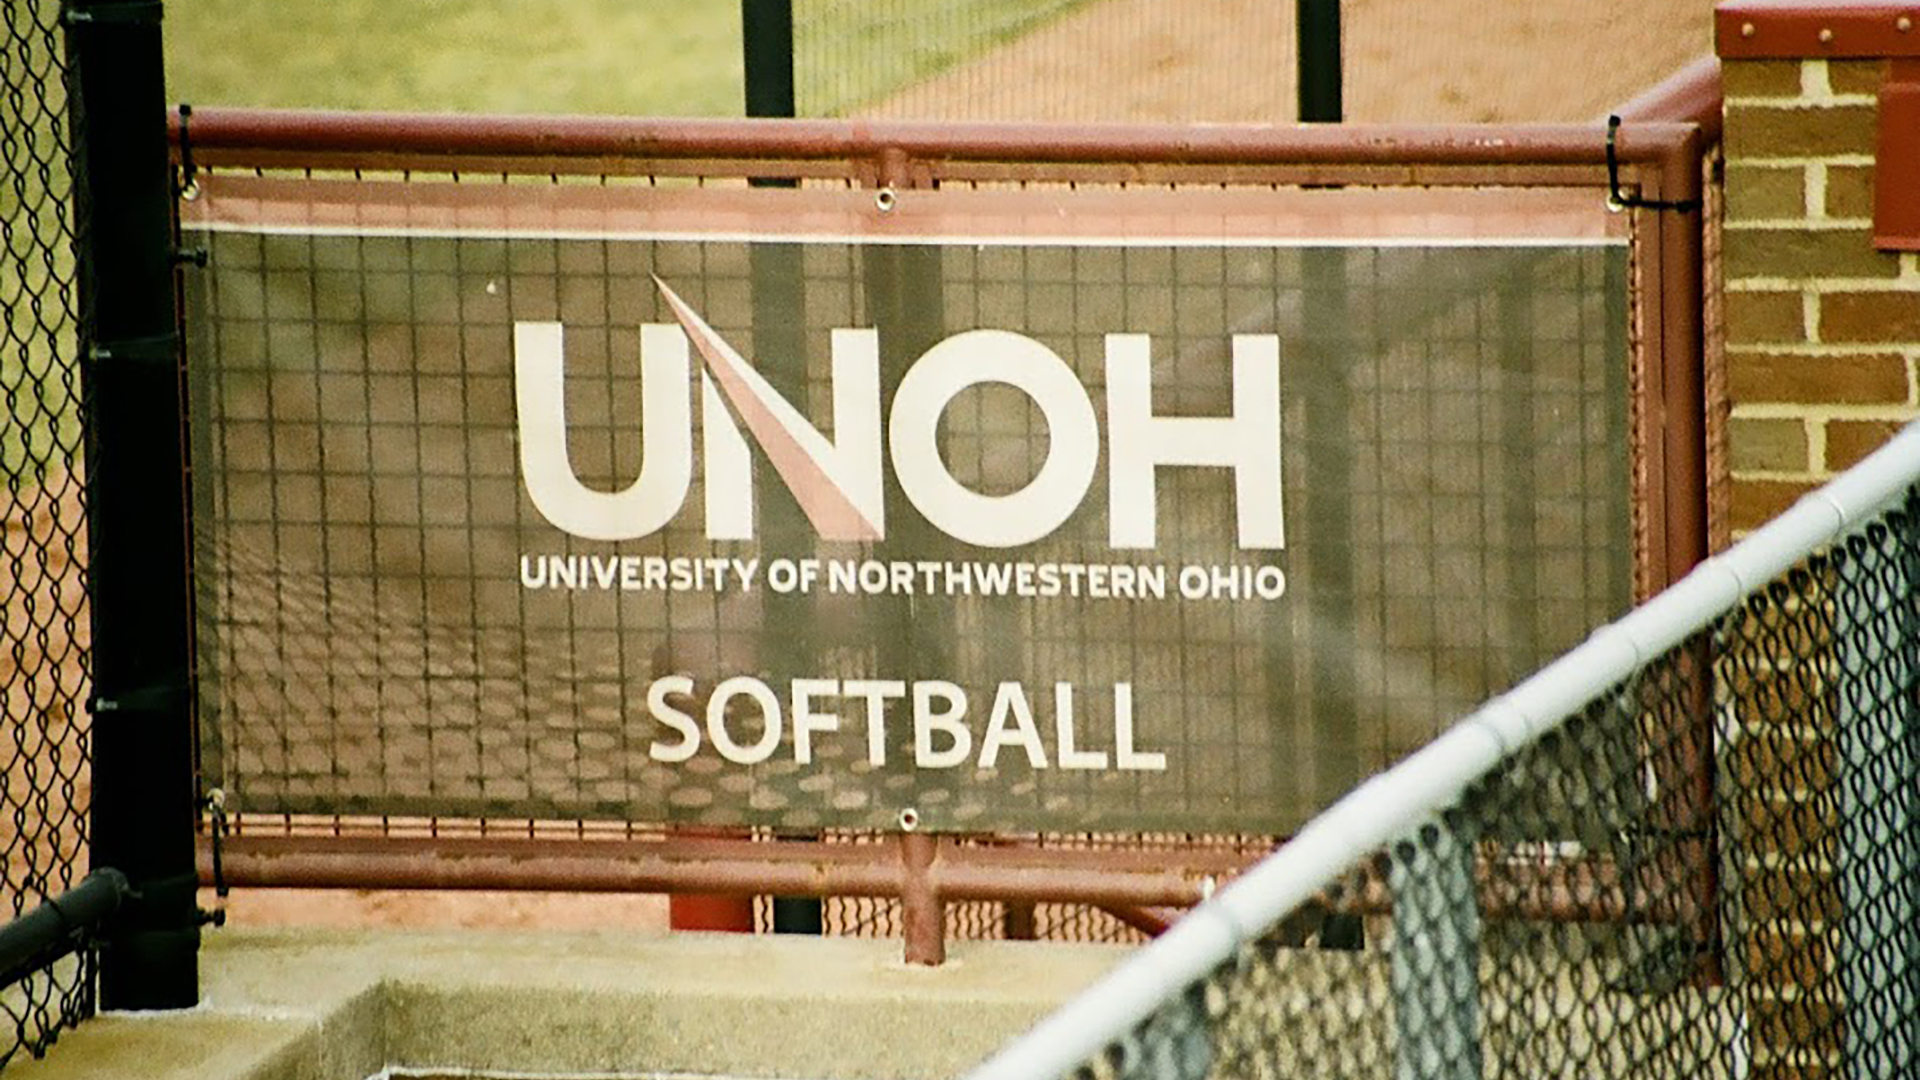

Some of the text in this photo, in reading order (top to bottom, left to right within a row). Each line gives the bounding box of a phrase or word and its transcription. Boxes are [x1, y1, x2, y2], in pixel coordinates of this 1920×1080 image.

[514, 273, 1285, 549] UNOH
[520, 554, 1287, 601] UNIVERSITY OF NORTHWESTERN OHIO
[647, 674, 1168, 772] SOFTBALL
